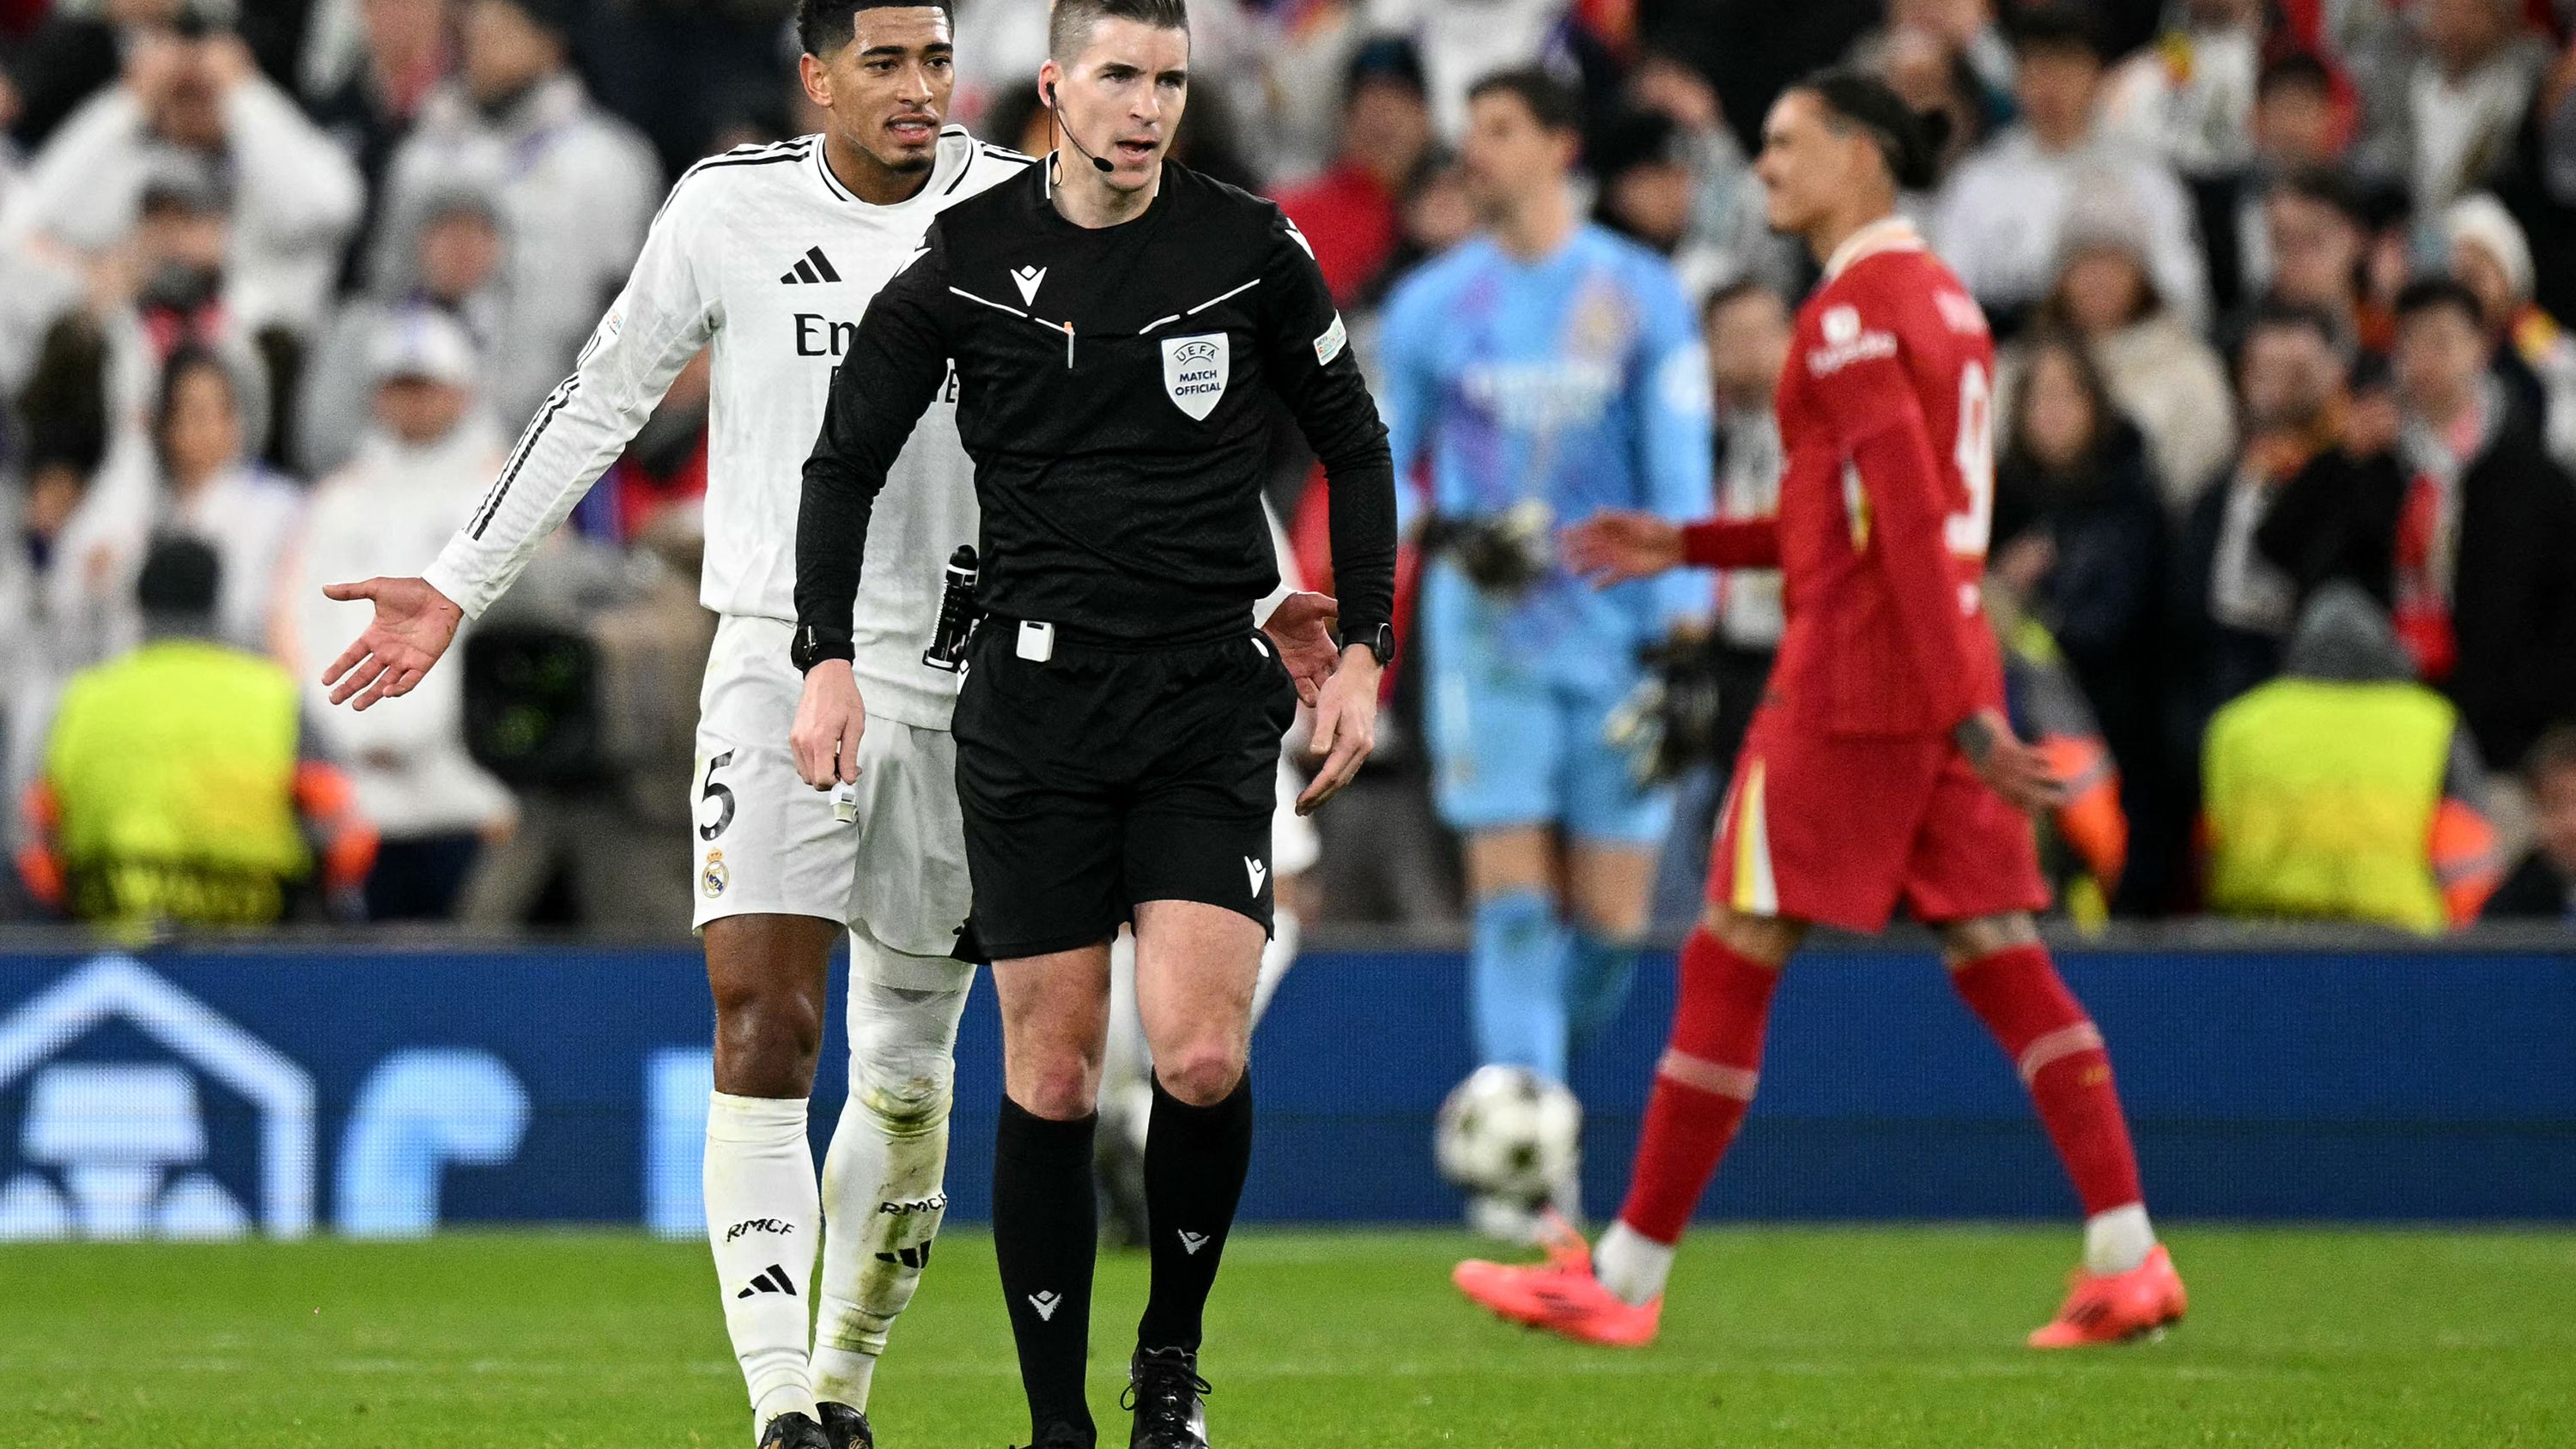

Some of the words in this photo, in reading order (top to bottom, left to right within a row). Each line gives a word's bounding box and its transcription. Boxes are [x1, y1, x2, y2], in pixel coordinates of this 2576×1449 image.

[1176, 345, 1215, 361] UEFA
[1179, 370, 1218, 382] MATCH
[1175, 382, 1222, 396] OFFICIAL
[700, 748, 736, 841] 5
[726, 1218, 795, 1242] RMCF
